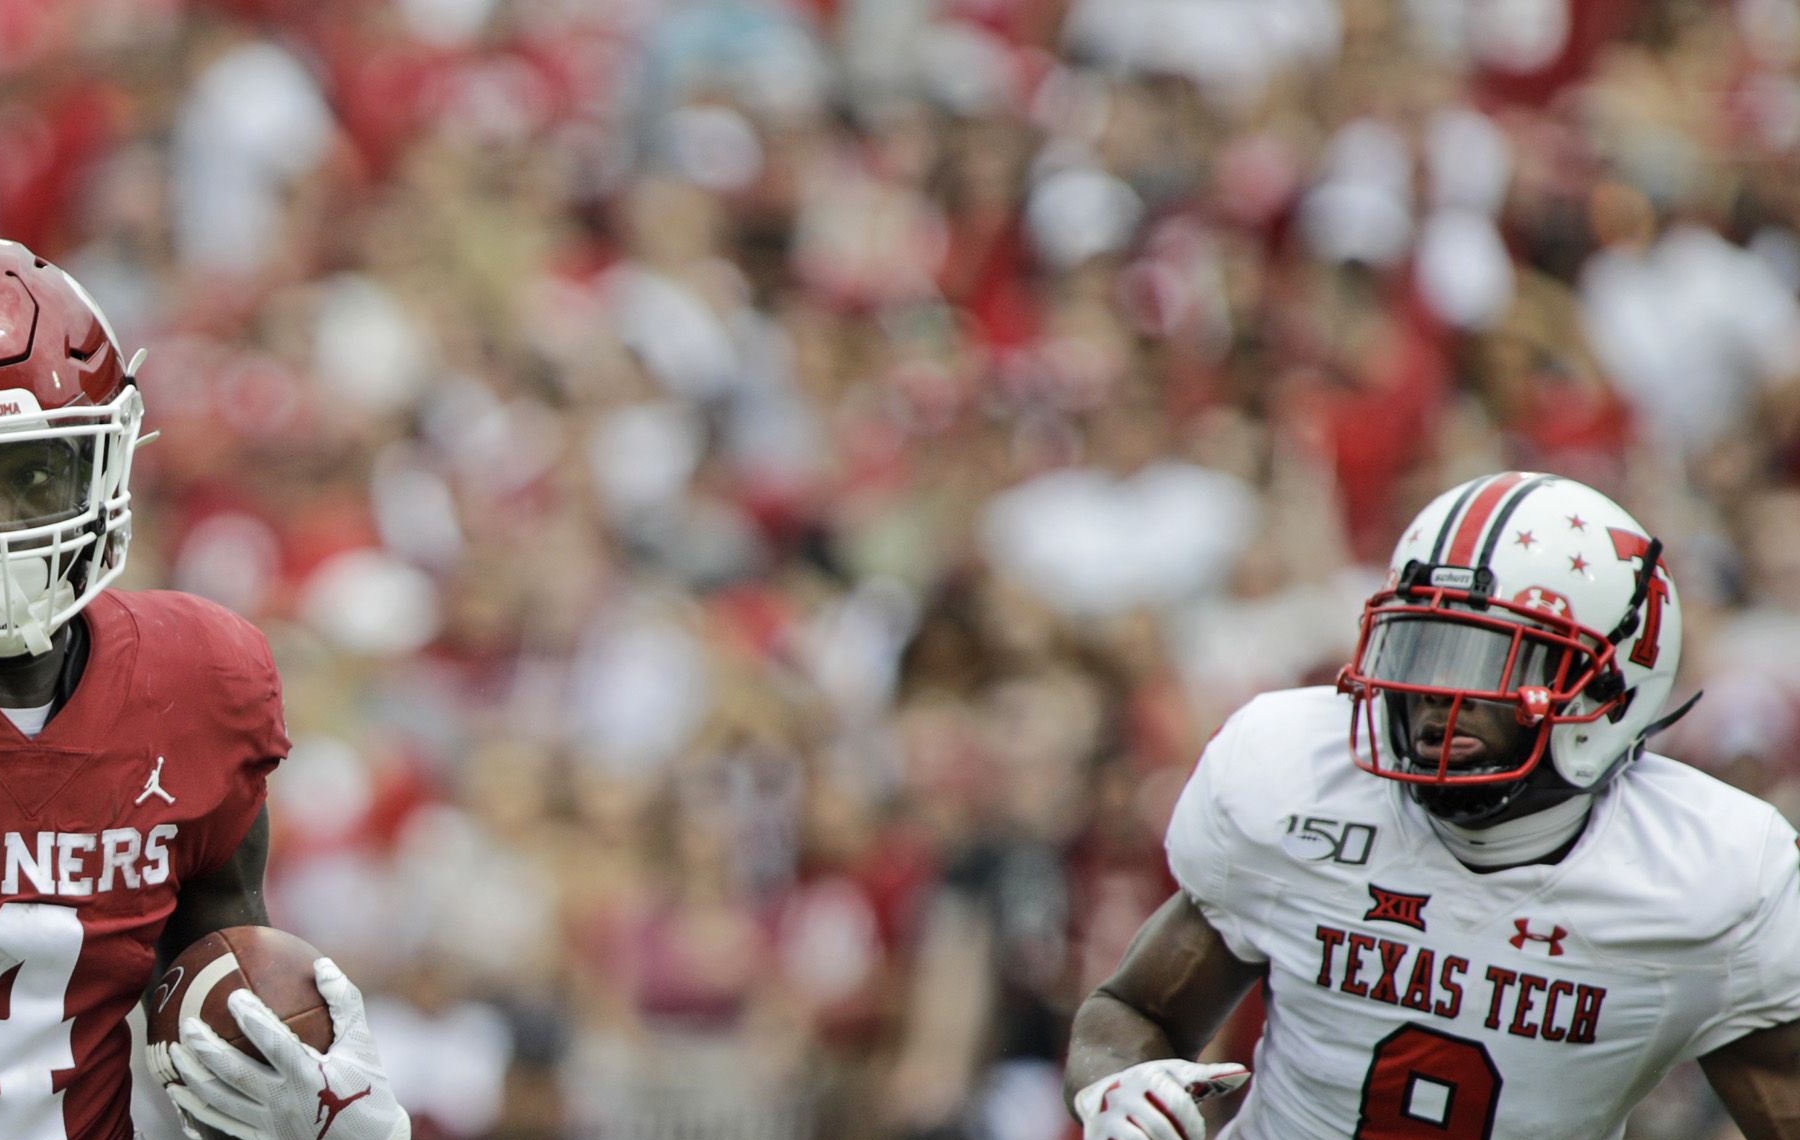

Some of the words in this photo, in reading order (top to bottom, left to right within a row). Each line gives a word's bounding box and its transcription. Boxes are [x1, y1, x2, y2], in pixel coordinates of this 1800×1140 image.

[1282, 813, 1378, 865] 150
[1315, 924, 1470, 1020] TEXAS
[1484, 964, 1607, 1044] TECH
